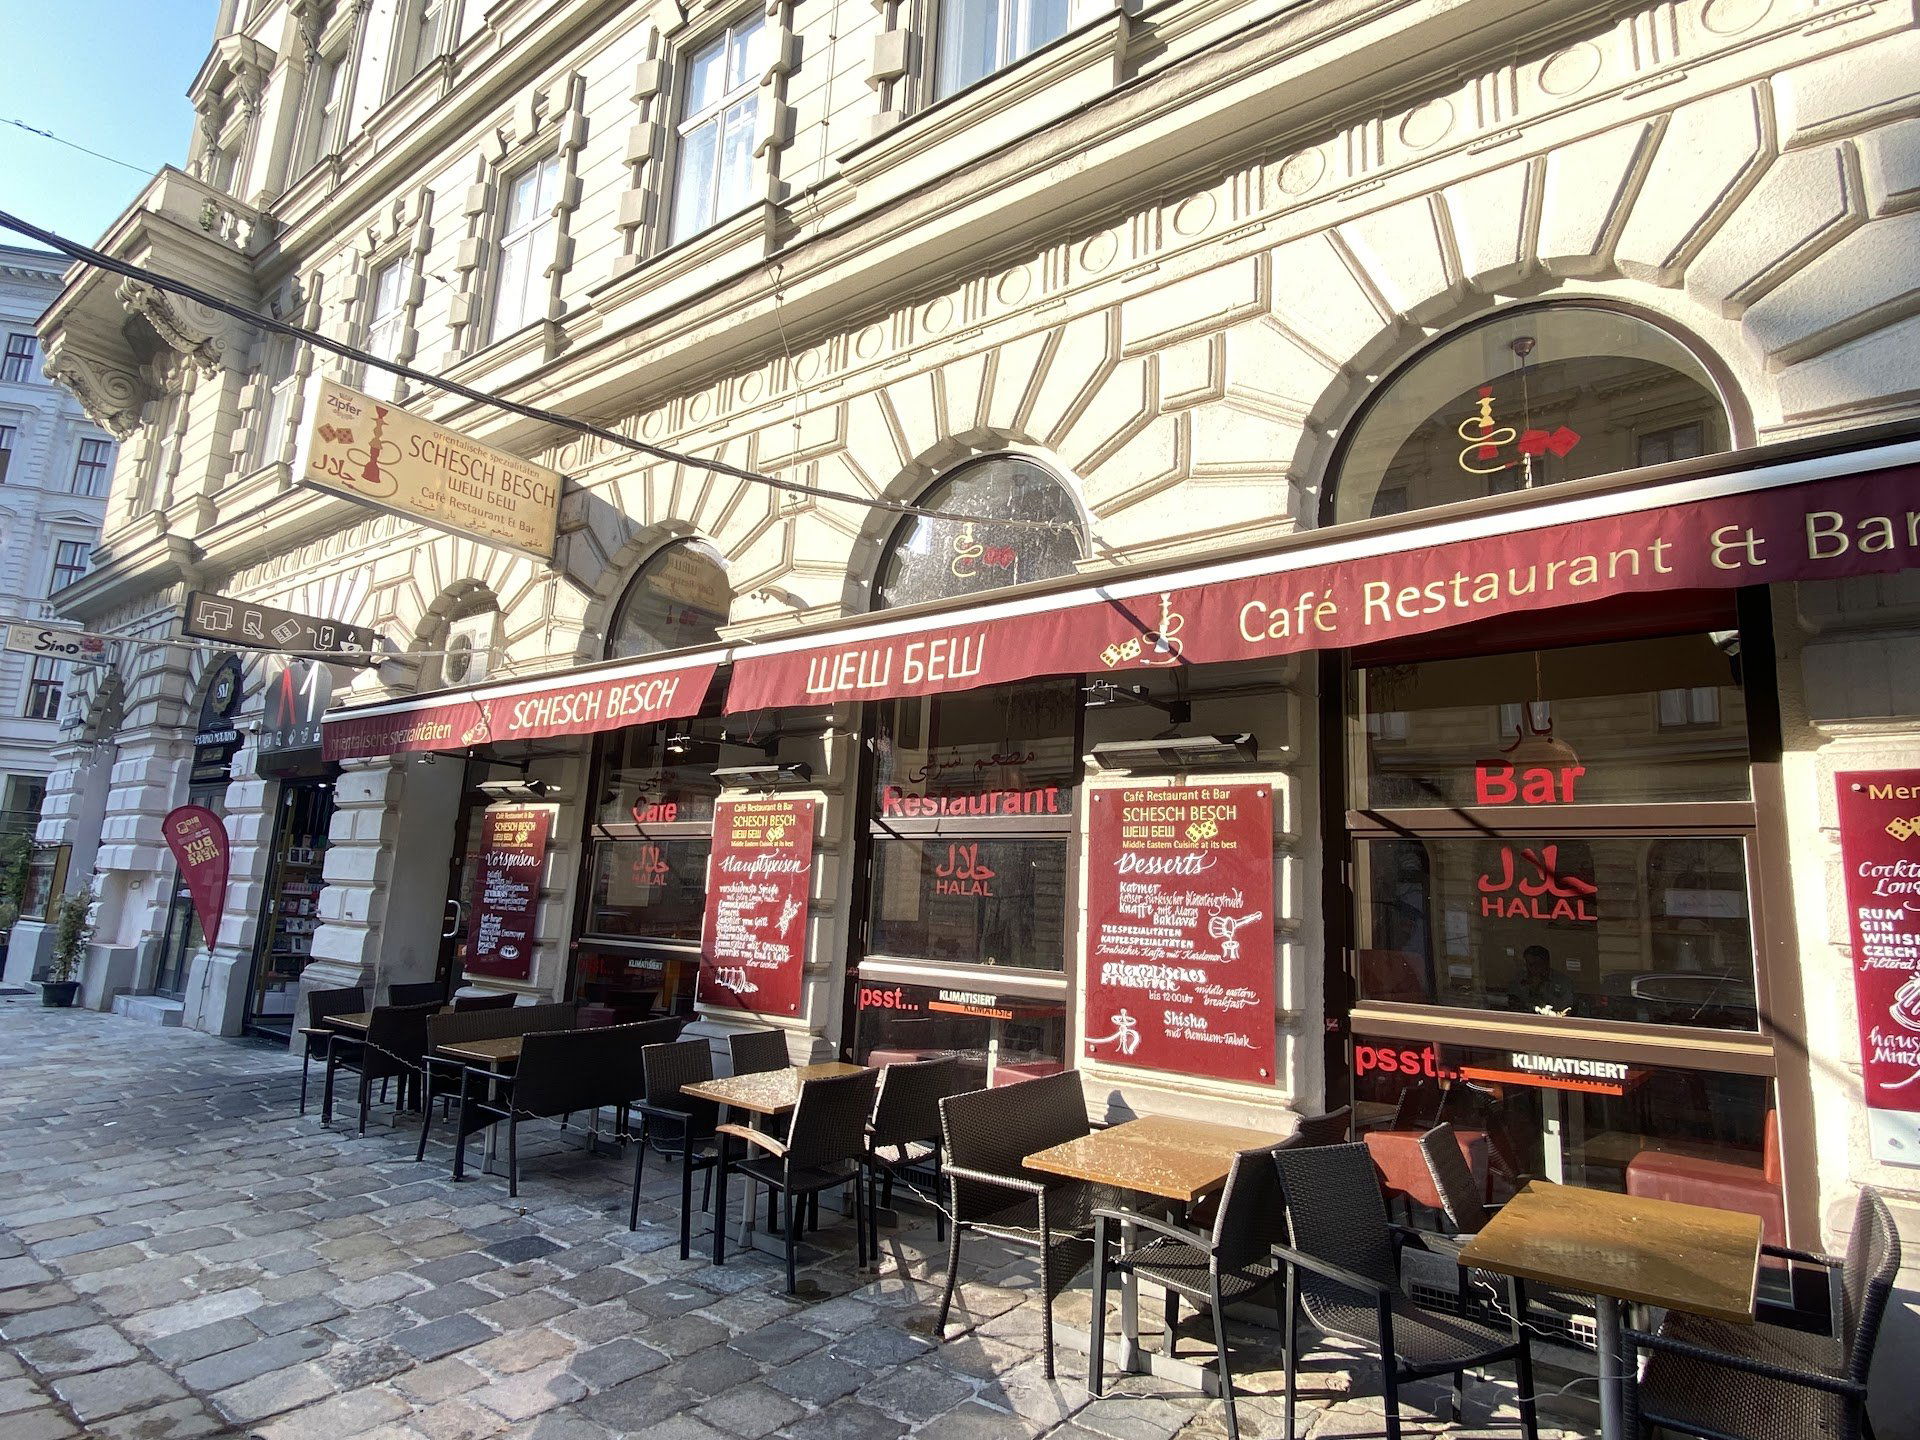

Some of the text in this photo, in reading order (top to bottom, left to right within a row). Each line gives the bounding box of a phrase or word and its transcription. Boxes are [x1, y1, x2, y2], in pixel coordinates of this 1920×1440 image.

[327, 394, 362, 416] Zipfer
[408, 434, 556, 508] SCHESCH BESCH
[448, 476, 516, 511] ШЕШ БЕШ
[421, 487, 446, 504] Café
[449, 496, 505, 523] Restaurant
[519, 520, 536, 534] Bar
[1238, 589, 1338, 644] Café
[1363, 536, 1673, 626] Restaurant
[1709, 525, 1767, 570] &
[34, 631, 80, 654] Sino
[806, 633, 986, 694] ШЕШ БЕШ
[509, 677, 680, 731] SCHESCH BESCH
[1475, 759, 1586, 805] Bar
[882, 785, 1061, 818] Restaurant
[1123, 791, 1144, 802] Café
[1146, 789, 1199, 801] Restaurant
[1213, 788, 1231, 799] Bar
[747, 803, 777, 812] Restaurant
[783, 802, 794, 811] Bar
[1122, 805, 1237, 822] SCHESCH BESCH
[732, 814, 796, 828] SCHESCH BESCH
[1122, 840, 1237, 849] Middle Eastern Cuisine at its best
[936, 842, 996, 880] حلال
[1114, 850, 1217, 875] Desserts
[1477, 844, 1599, 898] حلال
[936, 880, 994, 897] HALAL
[1481, 897, 1599, 921] HALAL
[1858, 907, 1905, 920] RUM
[1153, 913, 1198, 927] Baklava
[1860, 921, 1894, 932] GIN
[1101, 924, 1182, 937] TEESPEZIALITÄTEN
[1101, 935, 1194, 949] KAFFEESPEZIALITÄTEN
[1166, 950, 1181, 959] mit
[1862, 945, 1918, 958] CZECH
[1859, 957, 1916, 971] filtered
[939, 990, 998, 1007] KLIMATISIERT
[1148, 989, 1161, 1000] bis
[1195, 984, 1256, 999] middle eastern
[1203, 994, 1260, 1013] breakfast
[1163, 1010, 1208, 1029] Shisha
[1512, 1053, 1629, 1081] KLIMATISIERT
